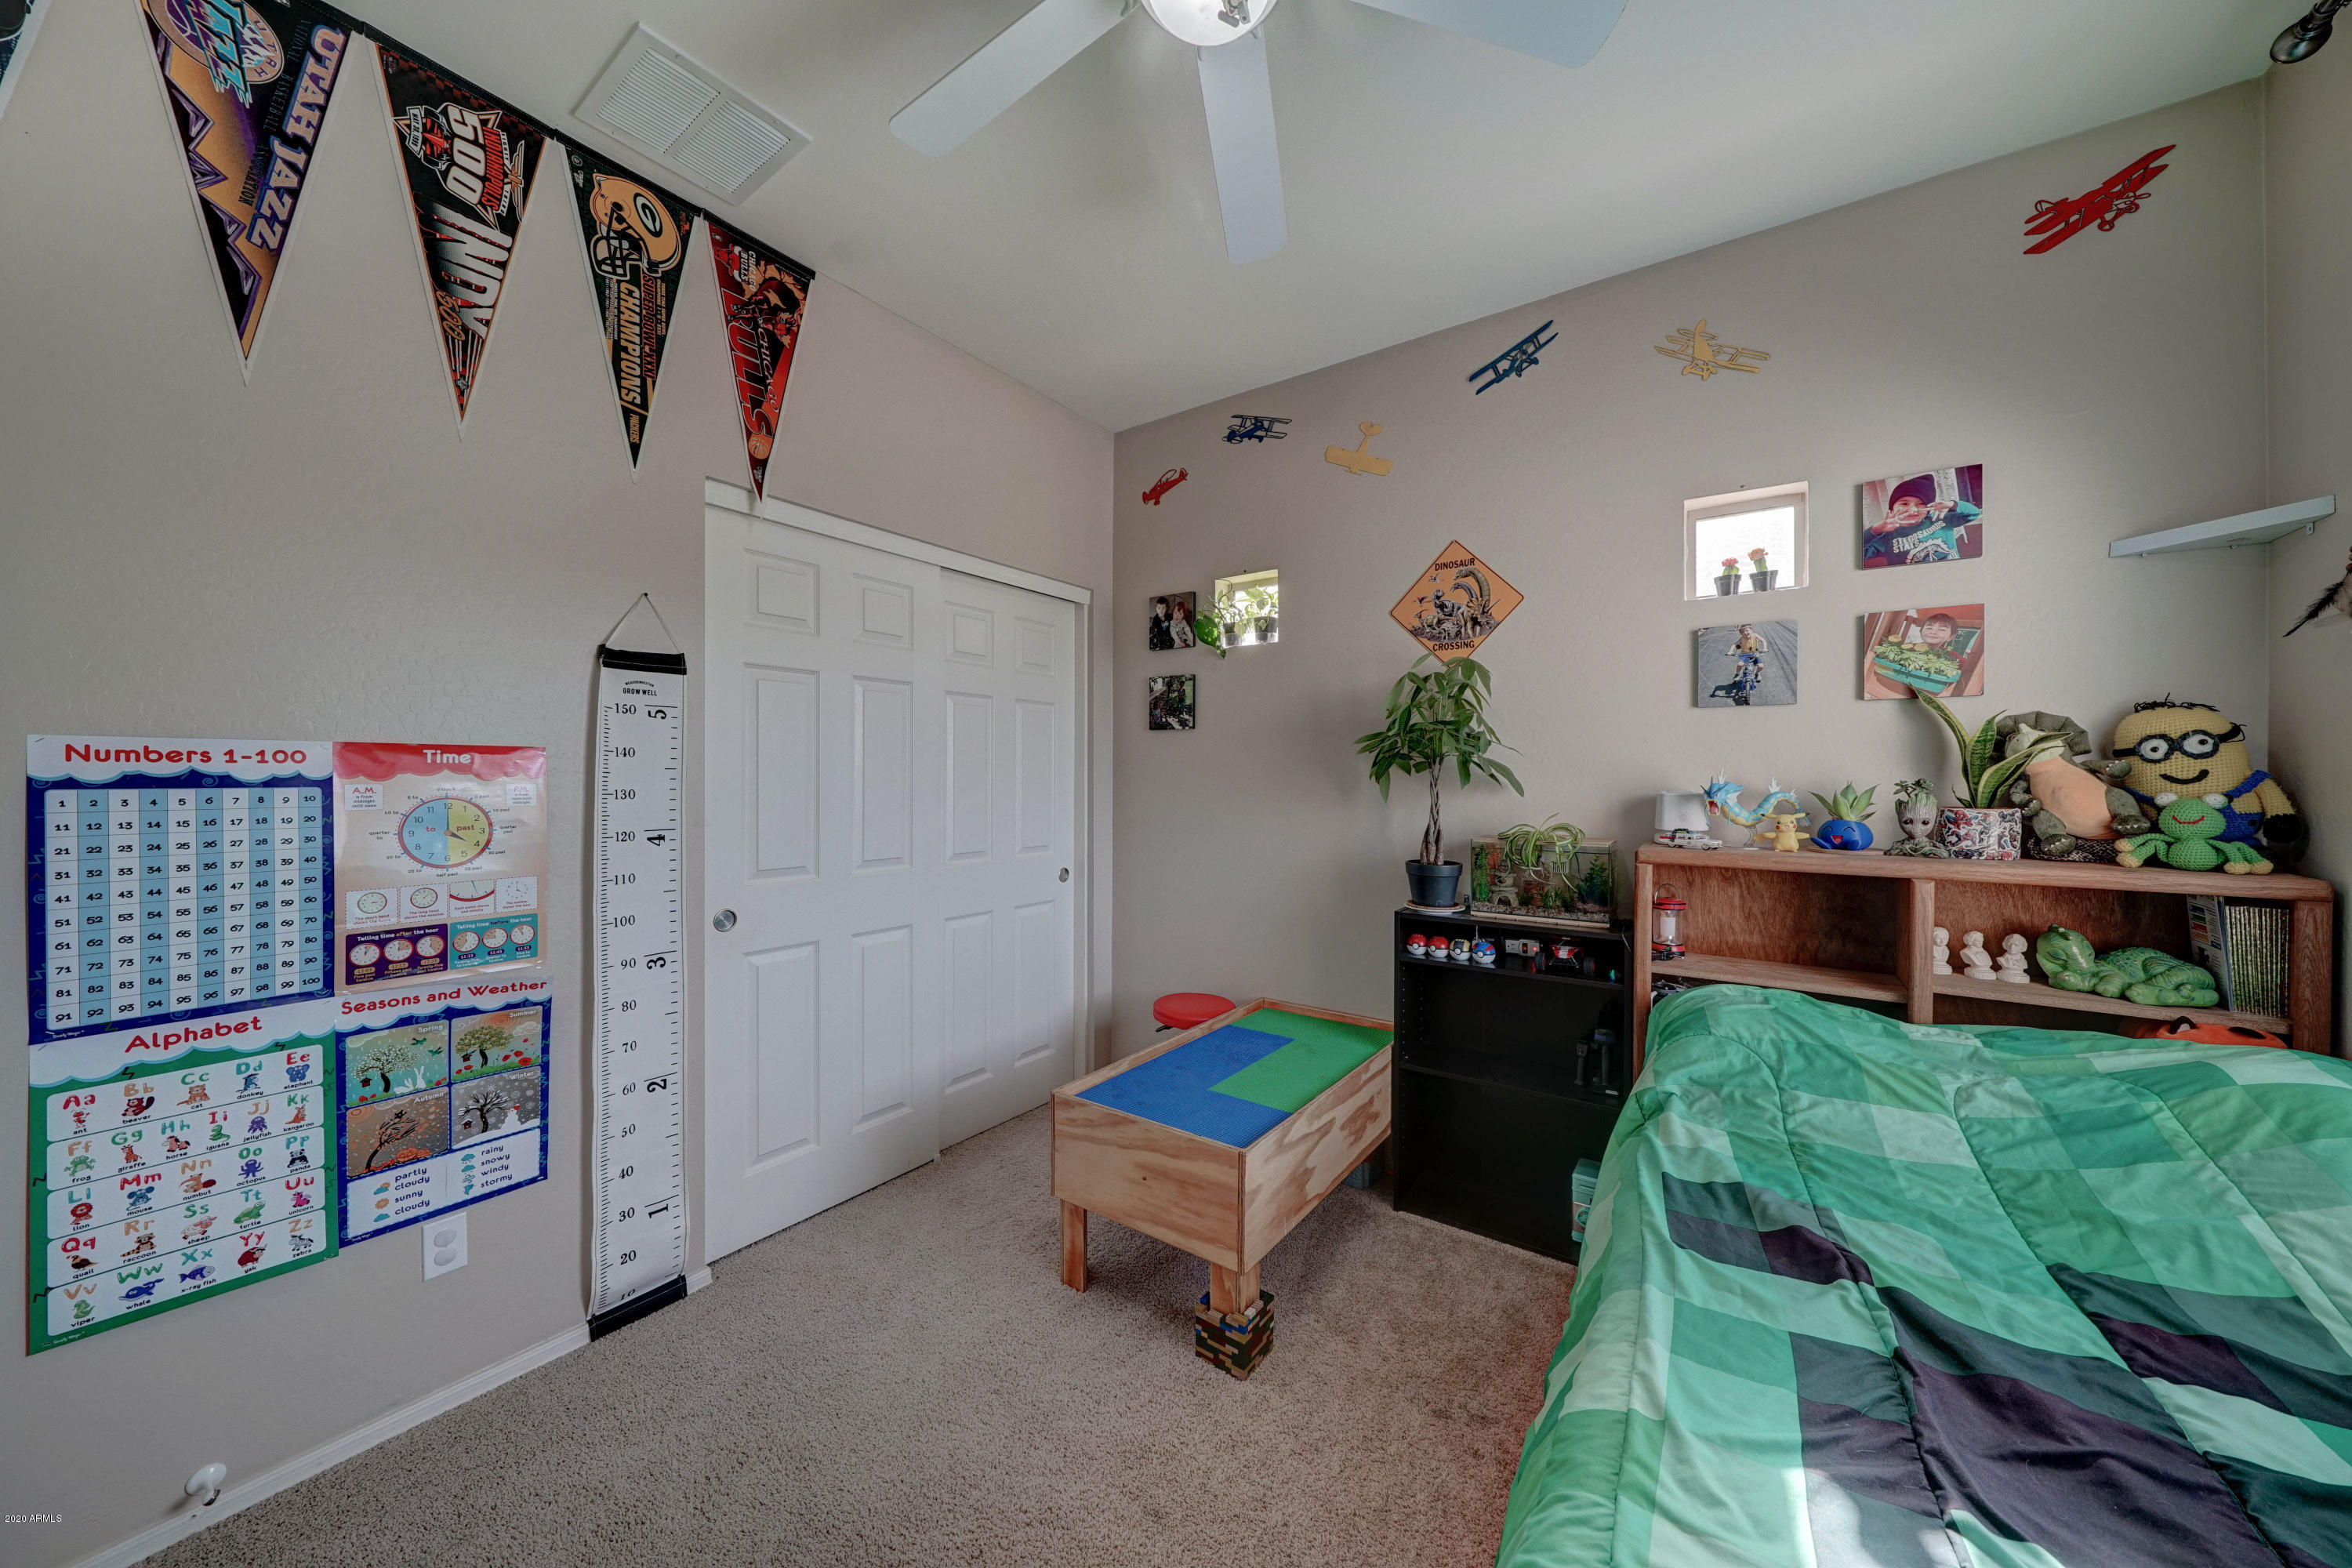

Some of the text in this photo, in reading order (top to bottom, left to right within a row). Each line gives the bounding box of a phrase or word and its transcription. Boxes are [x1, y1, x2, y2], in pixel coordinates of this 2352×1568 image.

[245, 25, 347, 251] UTAH JAZZ
[446, 105, 486, 205] 500
[481, 126, 504, 211] INDIANAPOLIS
[501, 189, 510, 215] THIRD
[414, 191, 513, 339] INDY
[437, 291, 466, 340] 500
[642, 274, 656, 380] SUPER BOWL XXXI
[620, 282, 641, 405] CHAMPIONS
[758, 328, 780, 413] CHICAGO
[630, 414, 639, 444] PACKERS
[1893, 521, 1946, 546] STEGOSAURUS
[1893, 539, 1919, 554] STATS
[1435, 557, 1475, 572] DINOSAUR
[1432, 640, 1475, 652] CROSSING
[616, 703, 636, 714] 150
[648, 710, 666, 719] 5
[65, 744, 307, 764] Numbers 1-100
[423, 750, 472, 764] Time
[616, 747, 635, 757] 140
[615, 789, 635, 799] 130
[456, 824, 475, 833] past
[616, 831, 635, 841] 120
[647, 834, 665, 846] 4
[615, 873, 635, 884] 110
[613, 915, 635, 927] 100
[621, 958, 636, 969] 90
[647, 957, 666, 969] 3
[88, 1009, 103, 1018] 92
[119, 1004, 134, 1013] 93
[176, 996, 191, 1004] 95
[204, 991, 218, 1000] 96
[256, 984, 269, 993] 98
[341, 981, 548, 1015] Seasons and Weather
[622, 1000, 636, 1011] 80
[510, 1009, 536, 1018] Summer
[125, 1016, 263, 1053] Alphabet
[418, 1024, 443, 1033] Spring
[622, 1041, 637, 1052] 70
[510, 1070, 535, 1080] Winter
[284, 1080, 314, 1090] elephant
[622, 1083, 635, 1095] 60
[646, 1077, 667, 1093] 2
[237, 1090, 263, 1100] donkey
[414, 1091, 444, 1103] Autumn
[122, 1114, 151, 1123] beaver
[283, 1122, 314, 1132] kangaroo
[622, 1124, 635, 1138] 50
[243, 1131, 272, 1142] jellyfish
[206, 1142, 230, 1151] iguana
[481, 1145, 503, 1156] rainy
[166, 1152, 187, 1160] horse
[481, 1153, 510, 1167] snowy
[118, 1161, 146, 1172] giraffe
[481, 1163, 509, 1176] windy
[618, 1166, 634, 1179] 40
[395, 1167, 427, 1182] partly
[481, 1173, 513, 1188] stormy
[237, 1176, 266, 1186] octopus
[395, 1176, 430, 1191] cloudy
[395, 1189, 423, 1202] sunny
[128, 1205, 152, 1216] mouse
[289, 1205, 314, 1215] unicorn
[395, 1199, 430, 1215] cloudy
[648, 1203, 669, 1218] 1
[619, 1207, 634, 1221] 30
[240, 1220, 261, 1229] turtle
[187, 1235, 210, 1244] sheep
[123, 1251, 156, 1264] raccoon
[292, 1248, 312, 1258] zebra
[621, 1250, 636, 1265] 20
[73, 1269, 94, 1279] quail
[181, 1278, 216, 1293] x-ray fish
[126, 1298, 151, 1310] whale
[71, 1316, 94, 1327] viper
